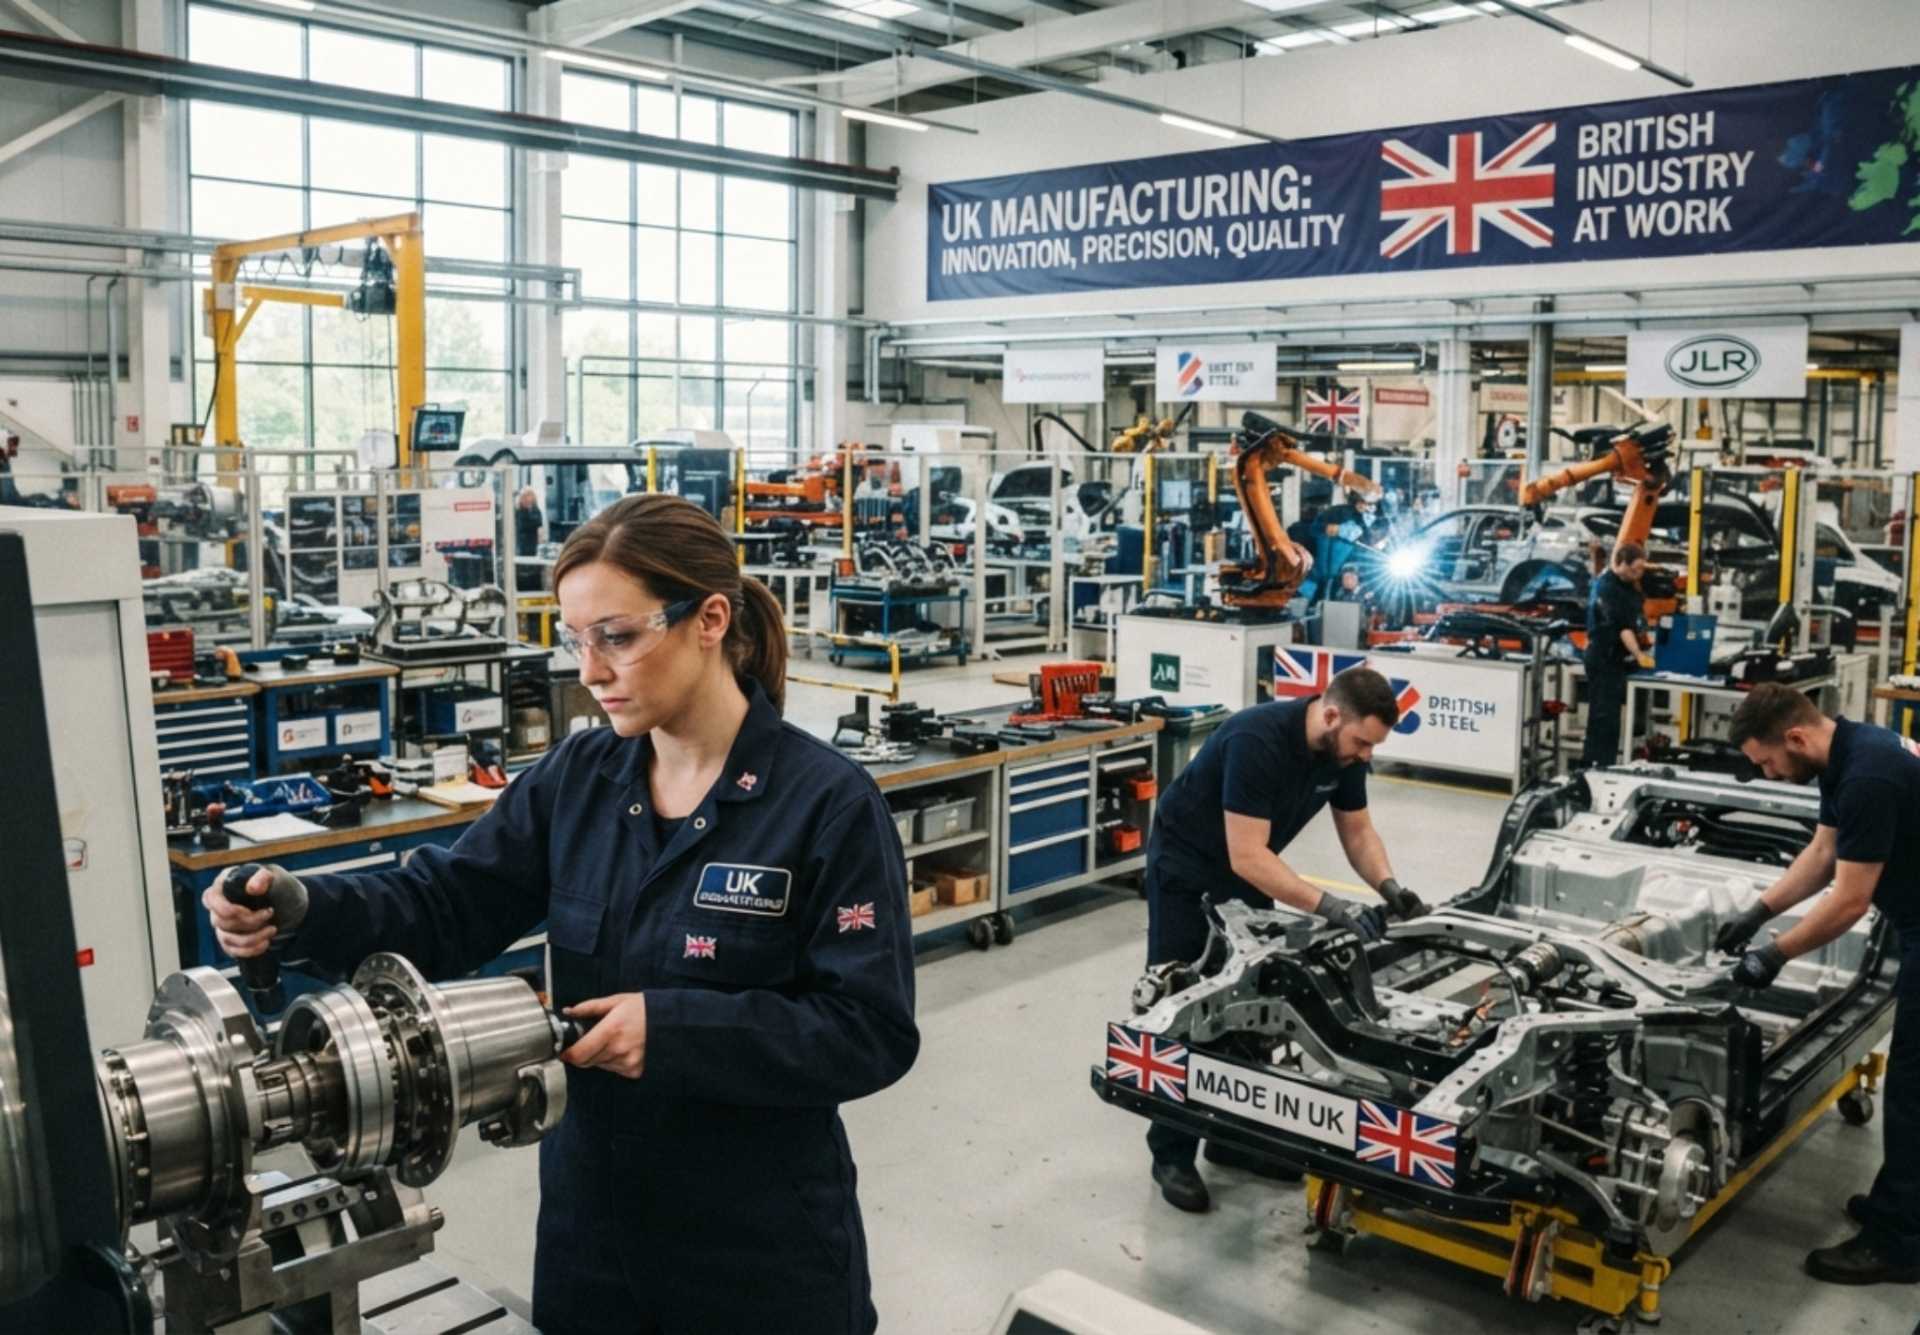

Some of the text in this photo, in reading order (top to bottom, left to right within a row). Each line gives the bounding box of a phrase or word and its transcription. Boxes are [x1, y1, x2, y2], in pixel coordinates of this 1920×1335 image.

[1577, 111, 1715, 159] BRITISH
[1576, 151, 1754, 201] INDUSTRY
[941, 164, 1312, 243] UK MANUFACTURING:
[1573, 196, 1734, 243] AT WORK
[941, 213, 1345, 276] INNOVATION, PRECISION, QUALITY
[1679, 350, 1747, 372] JLR
[725, 870, 764, 895] UK
[1195, 1069, 1344, 1135] MADE IN UK
